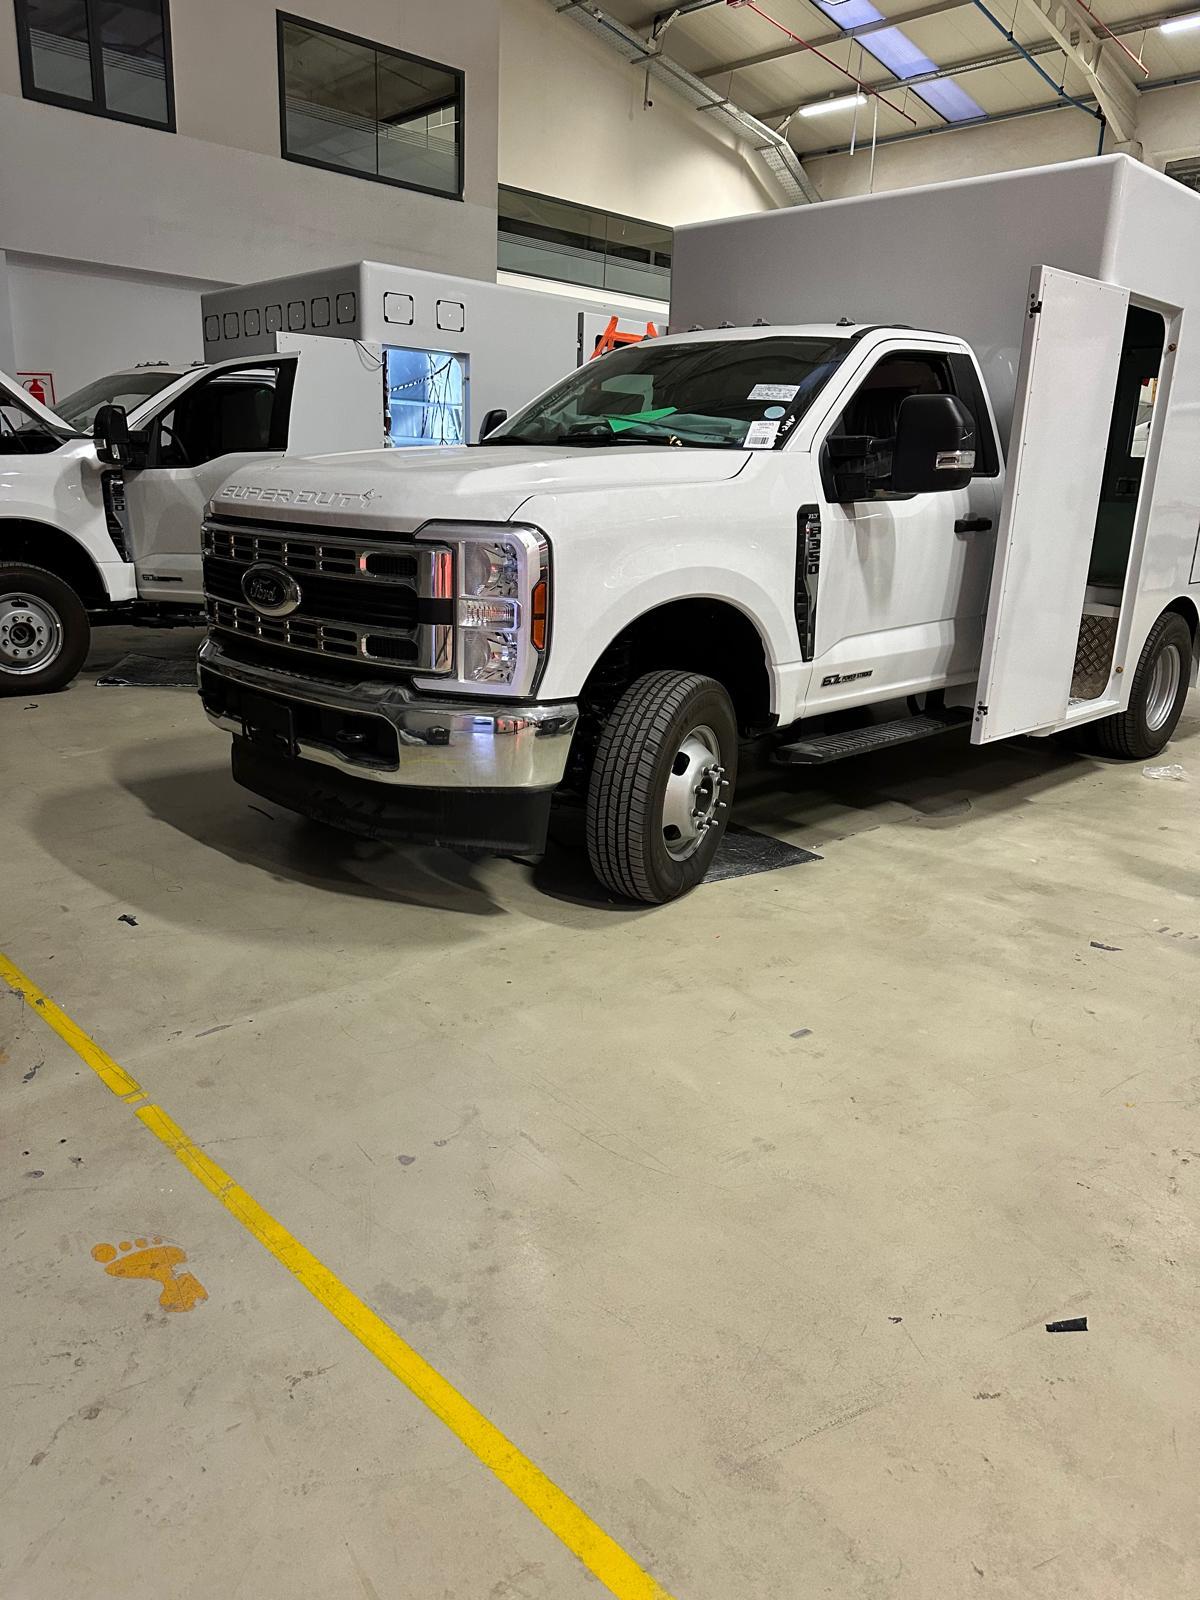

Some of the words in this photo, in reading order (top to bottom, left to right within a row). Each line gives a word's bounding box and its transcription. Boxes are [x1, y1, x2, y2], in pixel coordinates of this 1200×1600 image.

[221, 485, 294, 503] SUPER
[294, 488, 376, 508] DUTY
[249, 578, 278, 602] Ford
